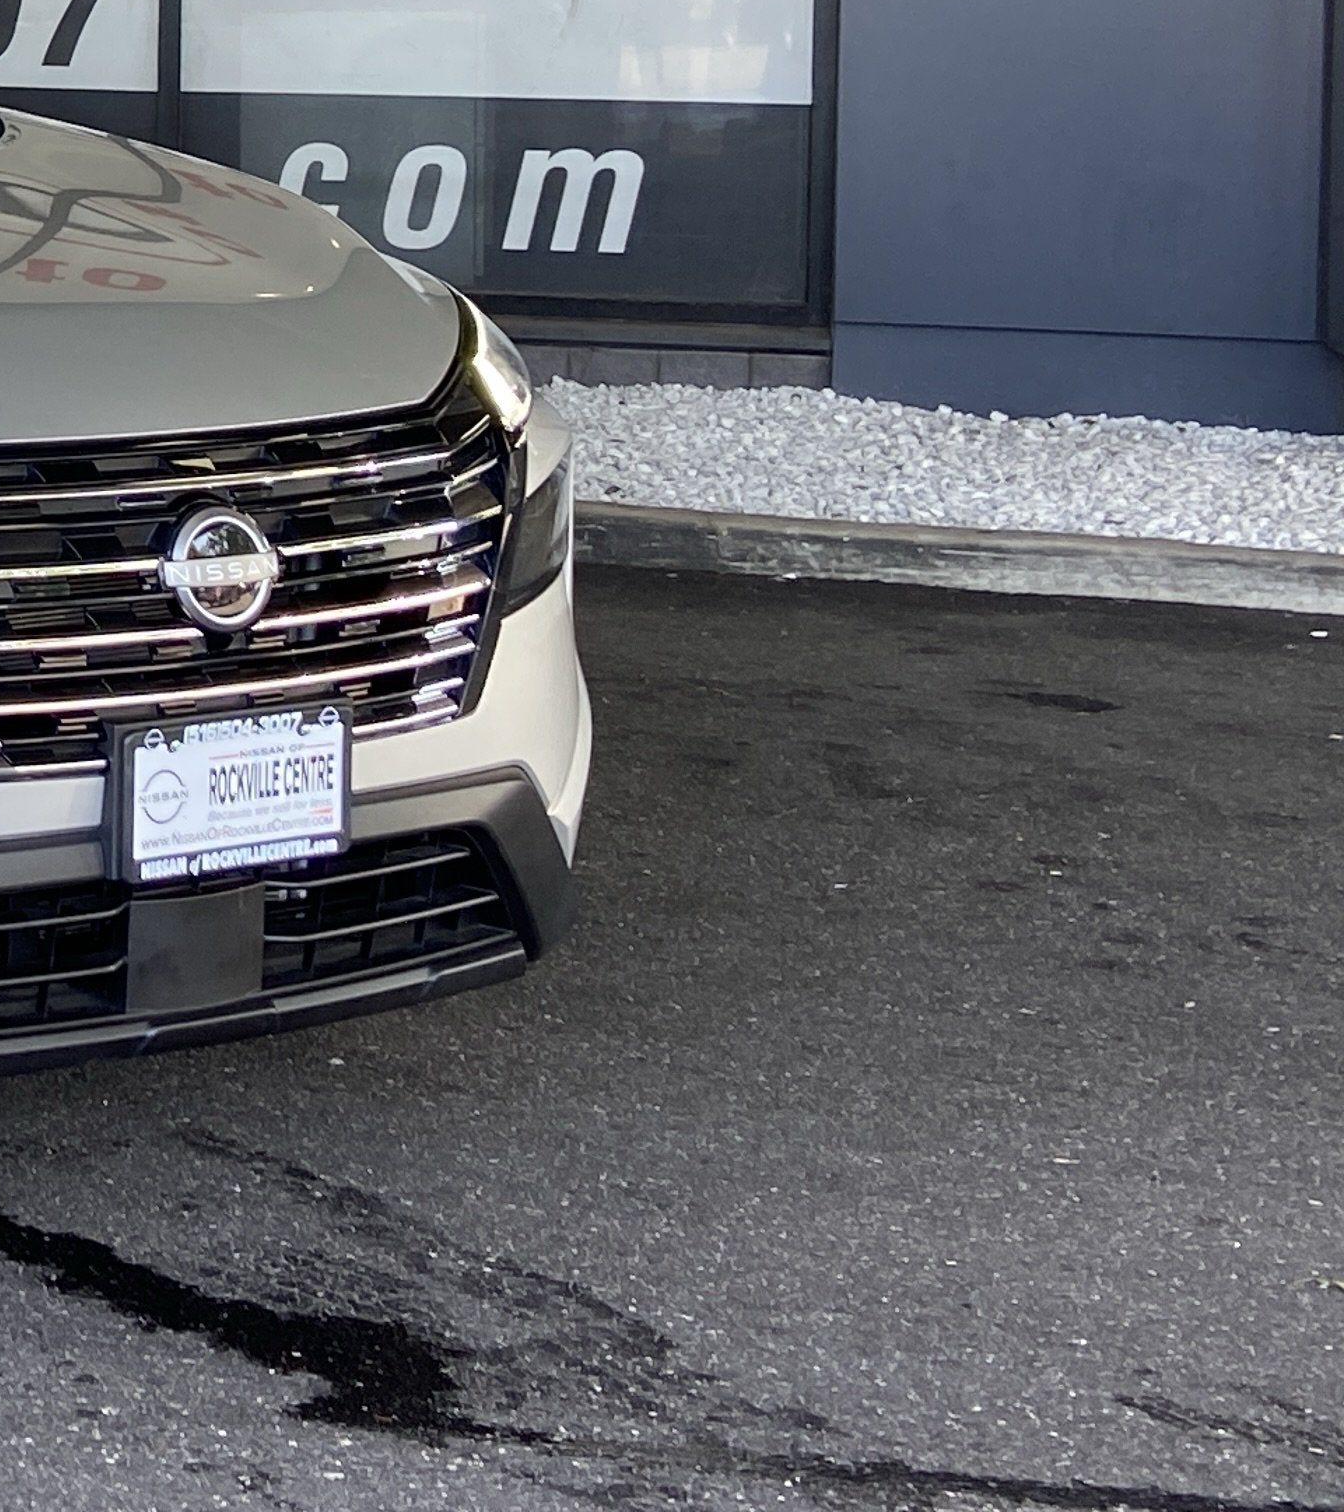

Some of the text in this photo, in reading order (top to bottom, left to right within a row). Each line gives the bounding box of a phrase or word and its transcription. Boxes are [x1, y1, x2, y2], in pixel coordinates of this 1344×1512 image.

[169, 560, 277, 584] NISSAN
[238, 744, 285, 759] NISSAN
[208, 753, 335, 806] ROCKVILLE CENTRE
[137, 788, 190, 805] NISSAN
[140, 856, 188, 881] NISSAN
